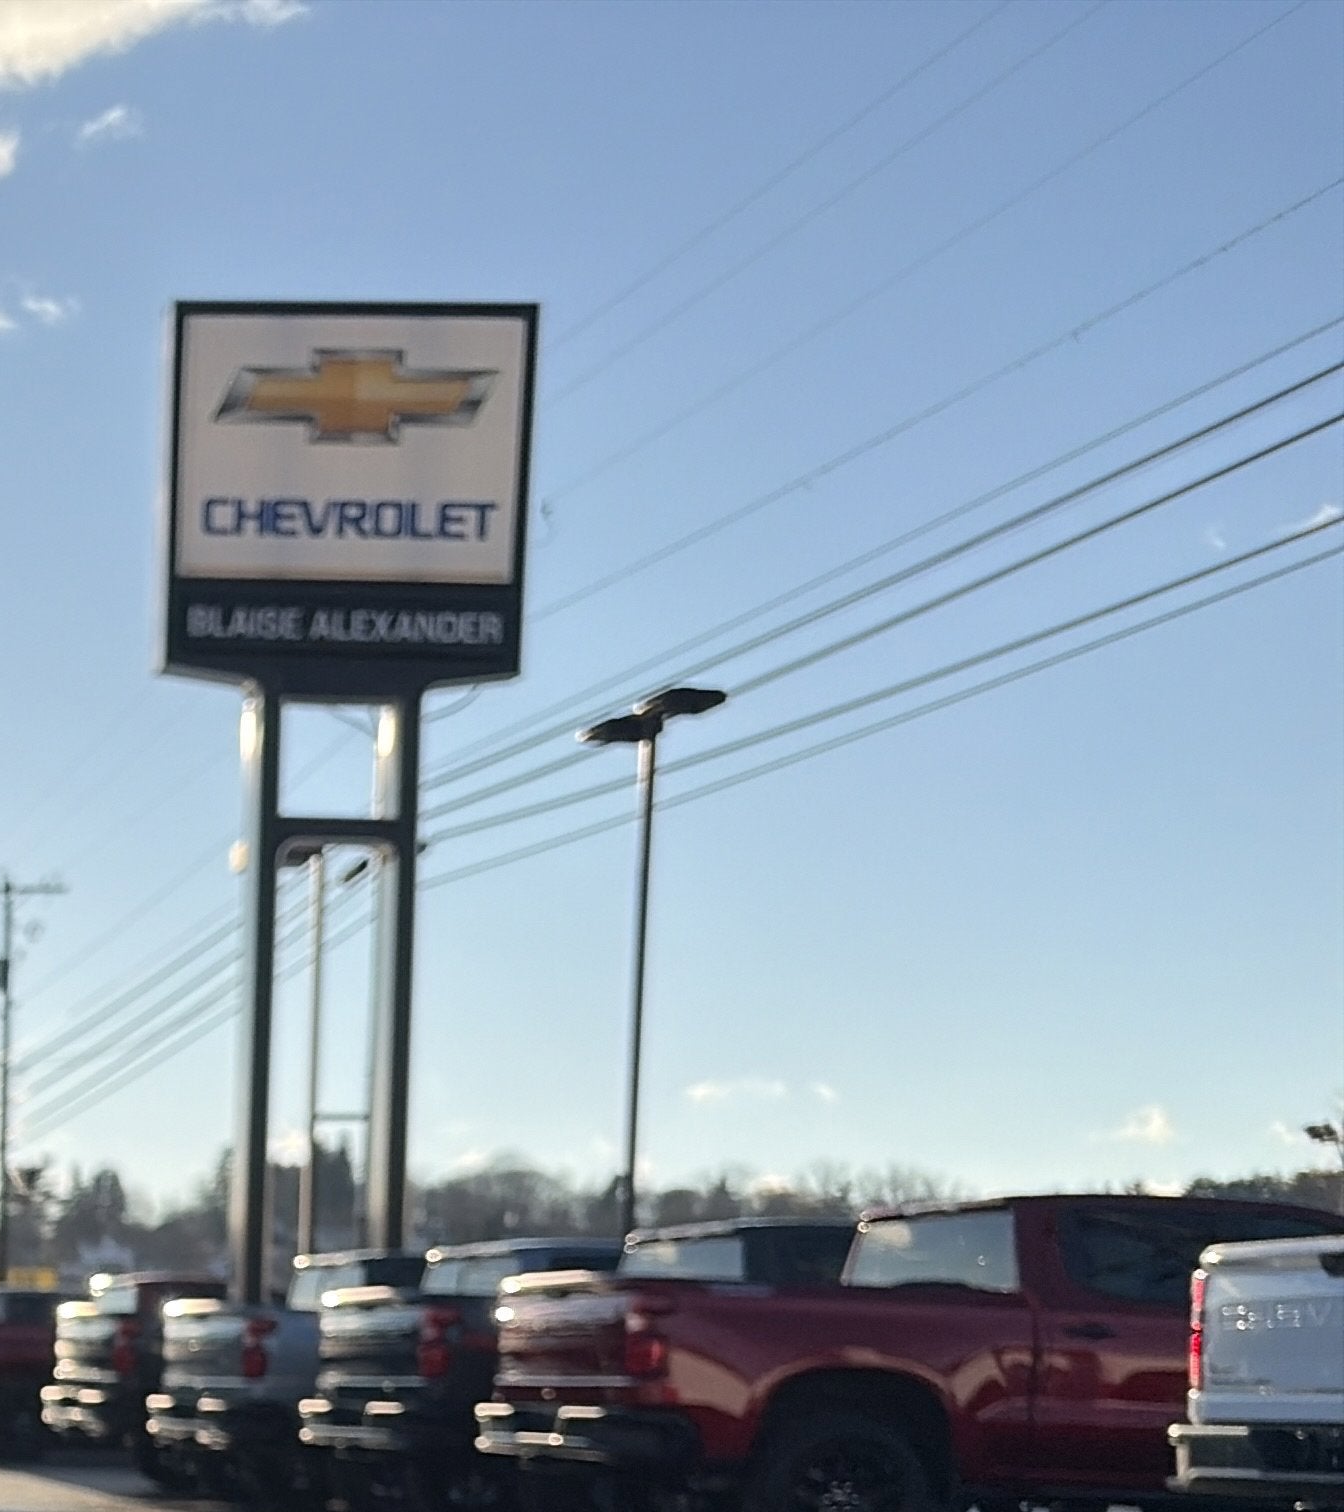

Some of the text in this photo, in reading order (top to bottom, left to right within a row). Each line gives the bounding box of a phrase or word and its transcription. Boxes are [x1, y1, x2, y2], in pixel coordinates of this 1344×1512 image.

[202, 497, 498, 541] CHEVROLET
[186, 605, 505, 645] BLAISE ALEXANDER
